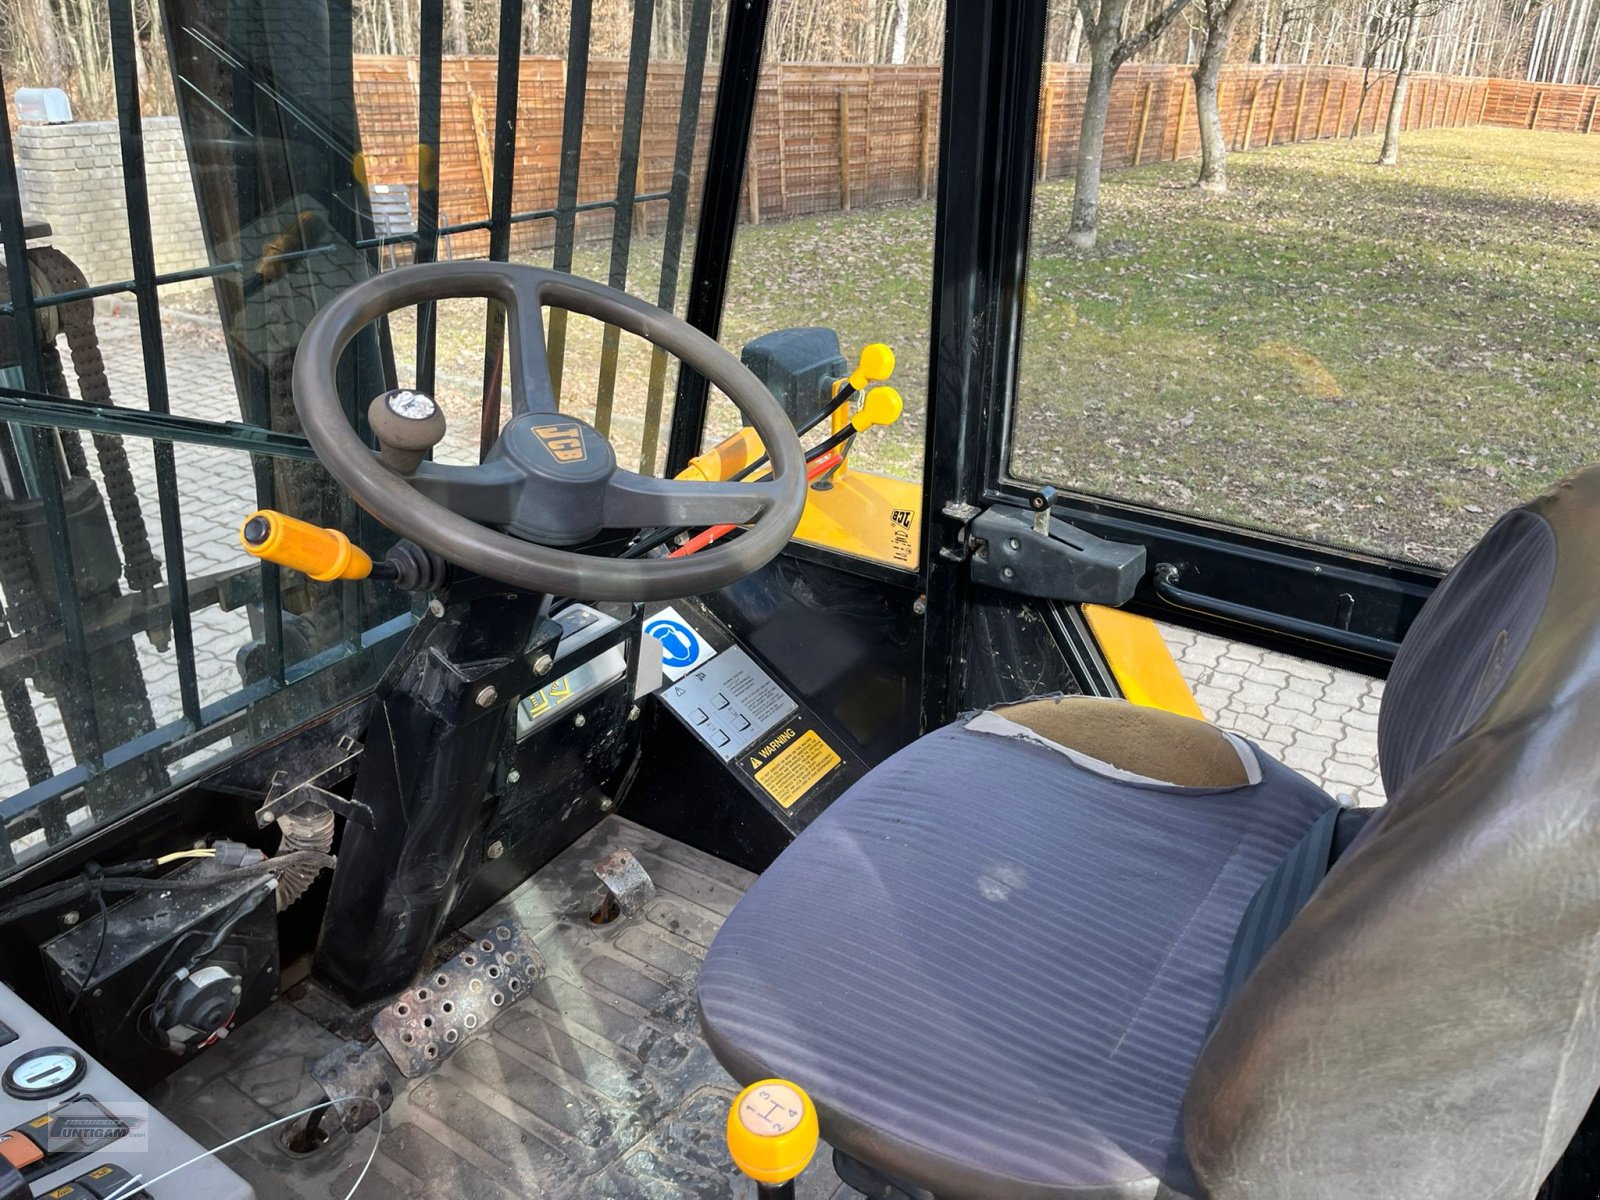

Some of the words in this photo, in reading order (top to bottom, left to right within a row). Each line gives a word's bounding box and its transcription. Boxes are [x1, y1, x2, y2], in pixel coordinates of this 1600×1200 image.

[534, 426, 584, 461] JCB
[758, 728, 797, 759] WARNING
[759, 1091, 770, 1100] 3
[788, 1109, 798, 1117] 4
[773, 1123, 785, 1132] 2
